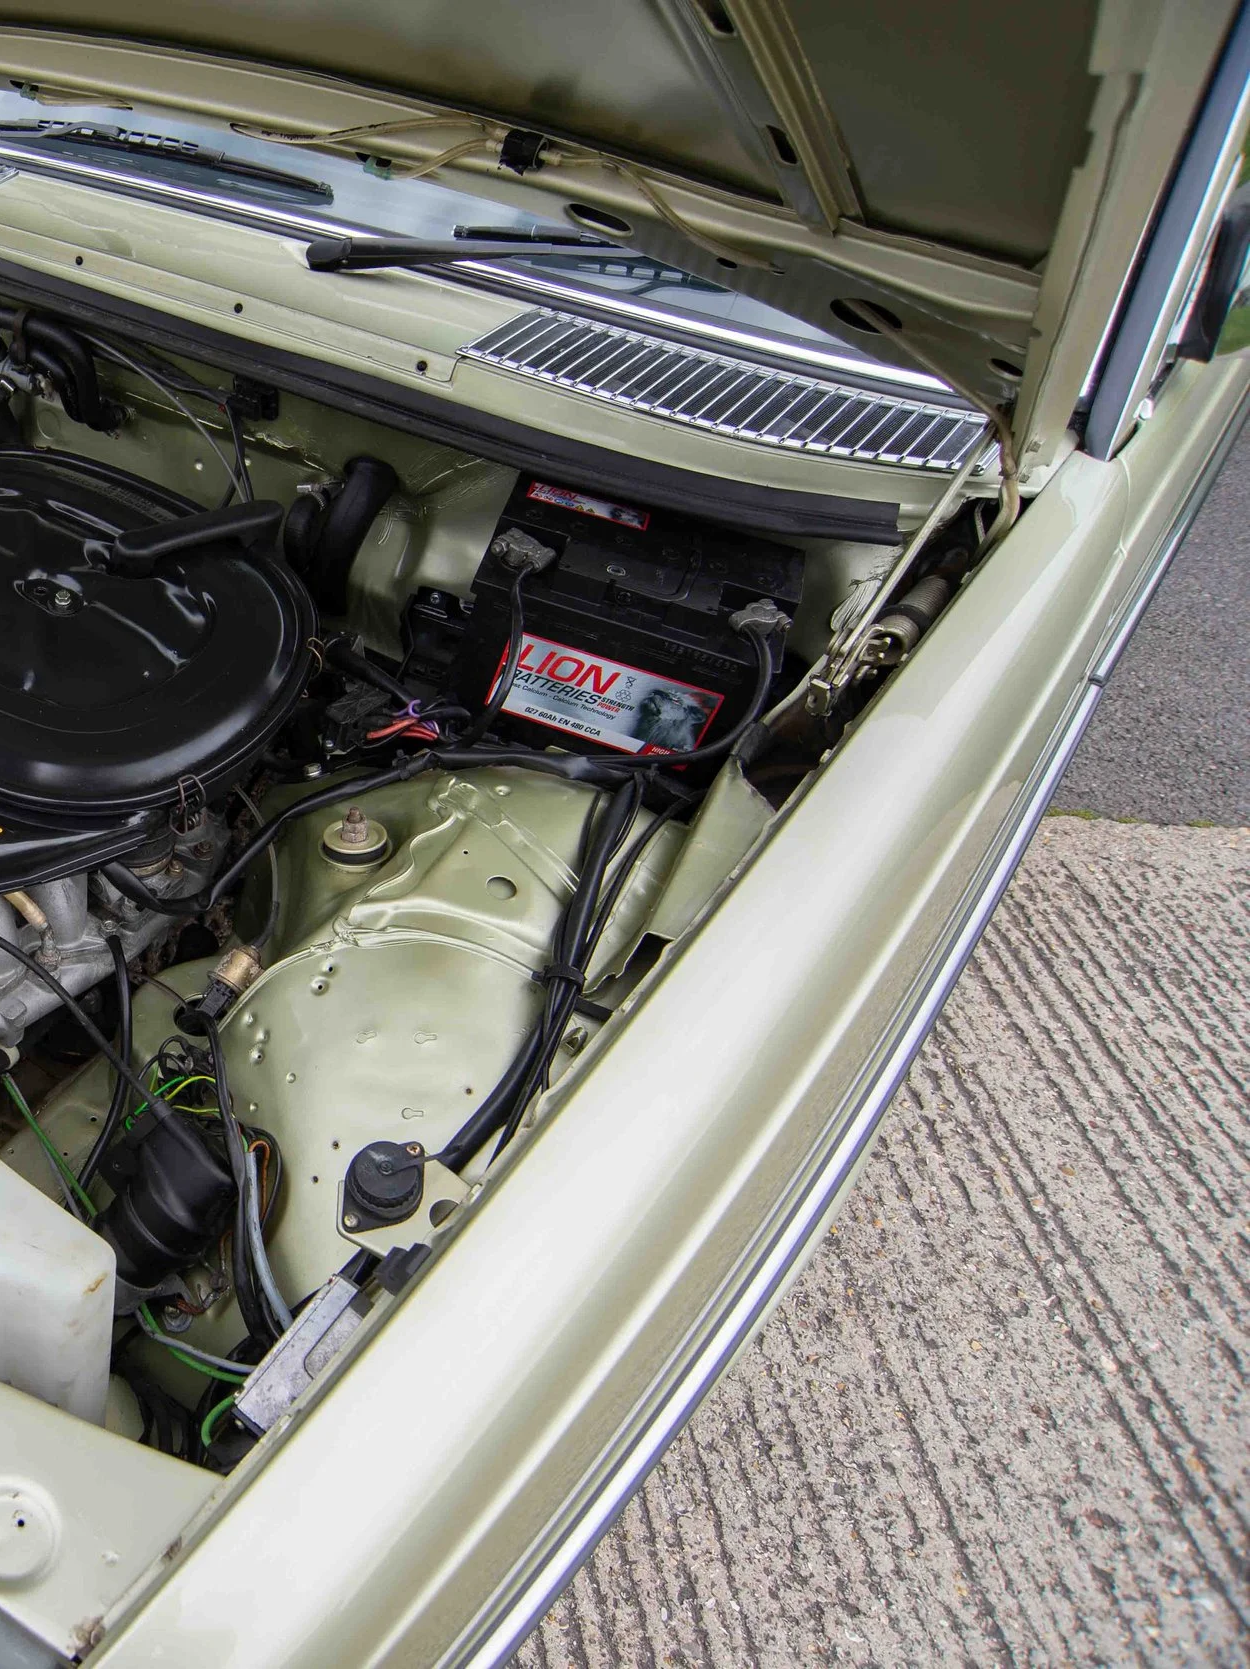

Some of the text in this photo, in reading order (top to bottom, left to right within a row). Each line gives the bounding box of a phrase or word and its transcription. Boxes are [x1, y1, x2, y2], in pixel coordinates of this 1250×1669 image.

[518, 643, 622, 695] LION
[522, 684, 548, 697] Calcium
[552, 695, 579, 708] Calcium
[580, 704, 616, 720] Technology
[597, 701, 621, 713] POWER
[600, 696, 635, 712] STRENGTH
[524, 706, 601, 737] 027 60Ah EN 480 CCA
